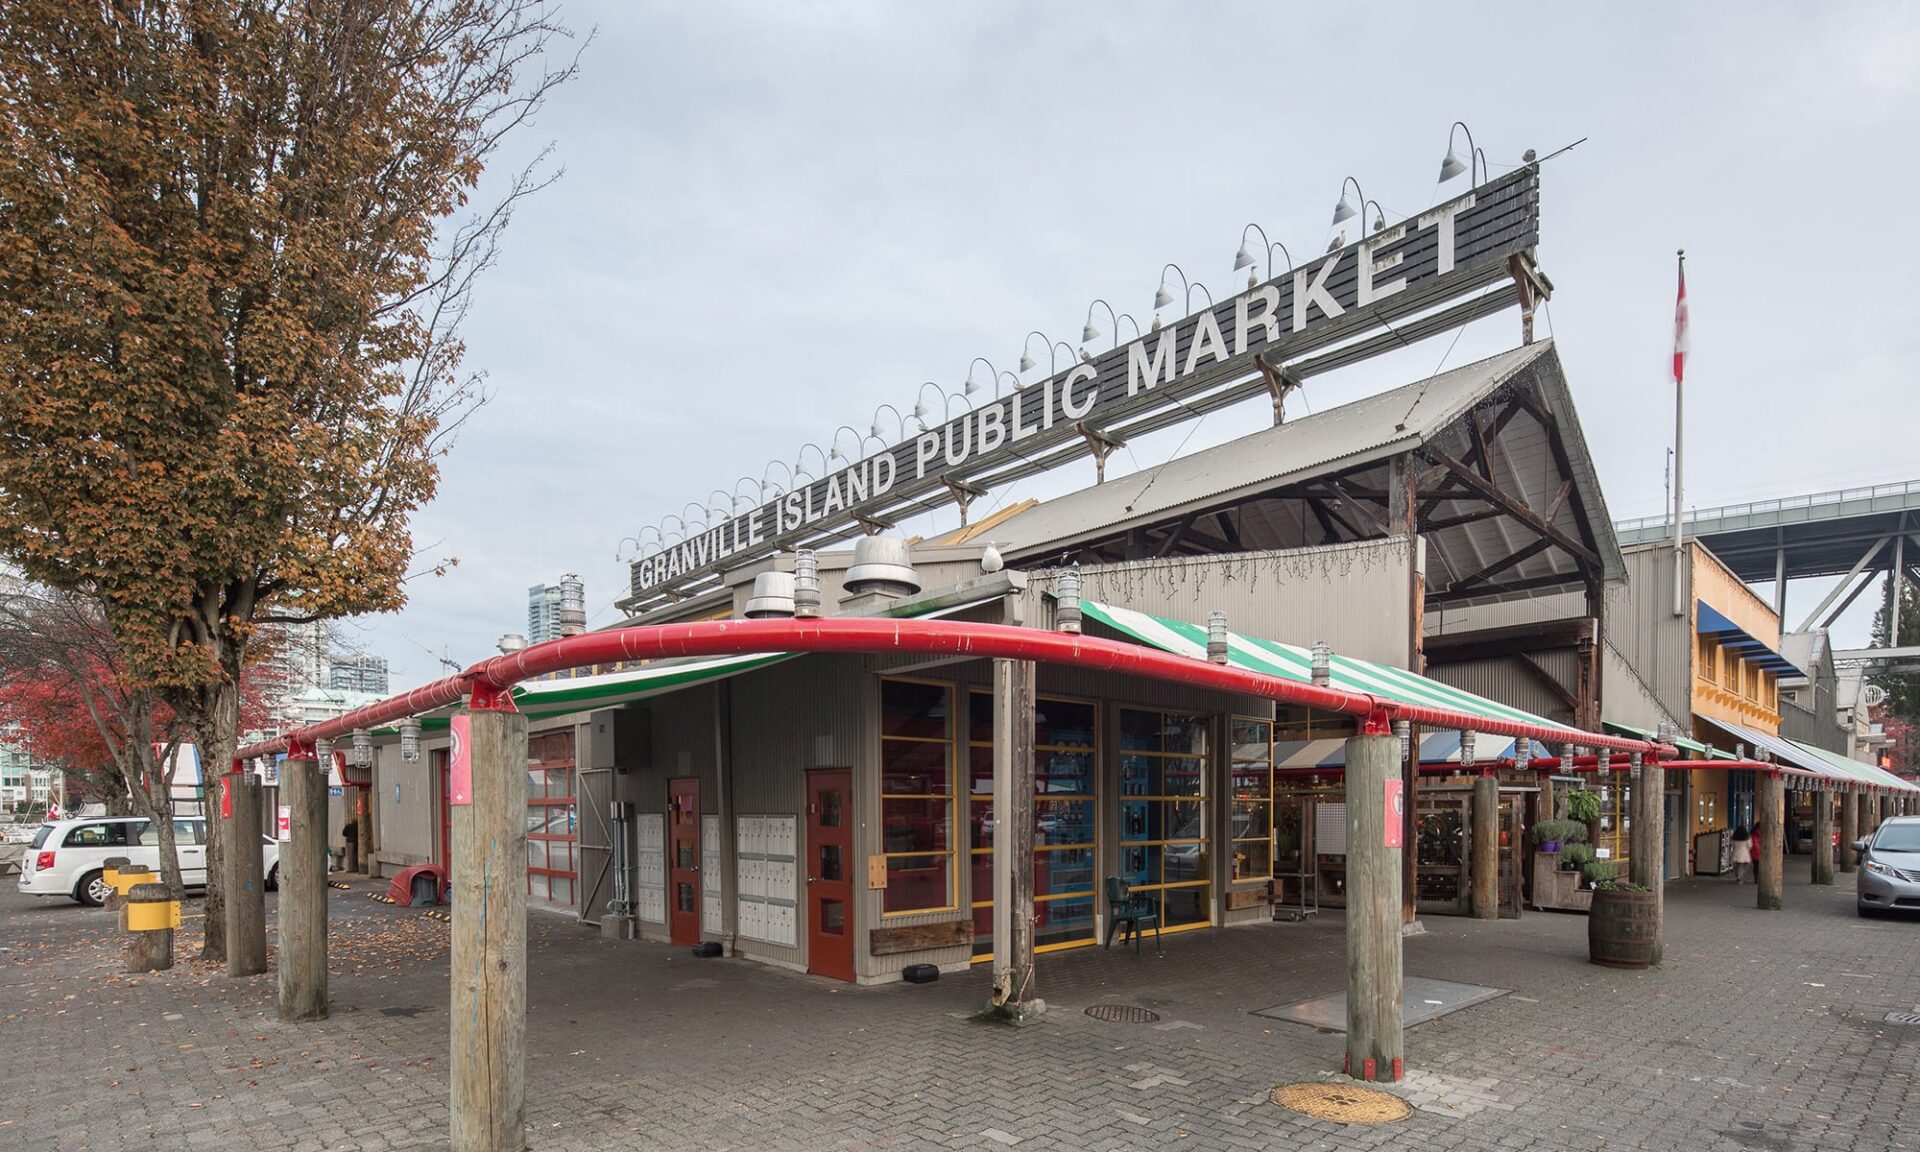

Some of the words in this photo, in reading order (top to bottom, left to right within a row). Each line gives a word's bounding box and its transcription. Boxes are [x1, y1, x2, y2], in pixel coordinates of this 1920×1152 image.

[639, 507, 764, 590] GRANVILLE
[776, 451, 896, 535] ISLAND
[916, 364, 1098, 479] PUBLIC
[1127, 193, 1476, 398] MARKET
